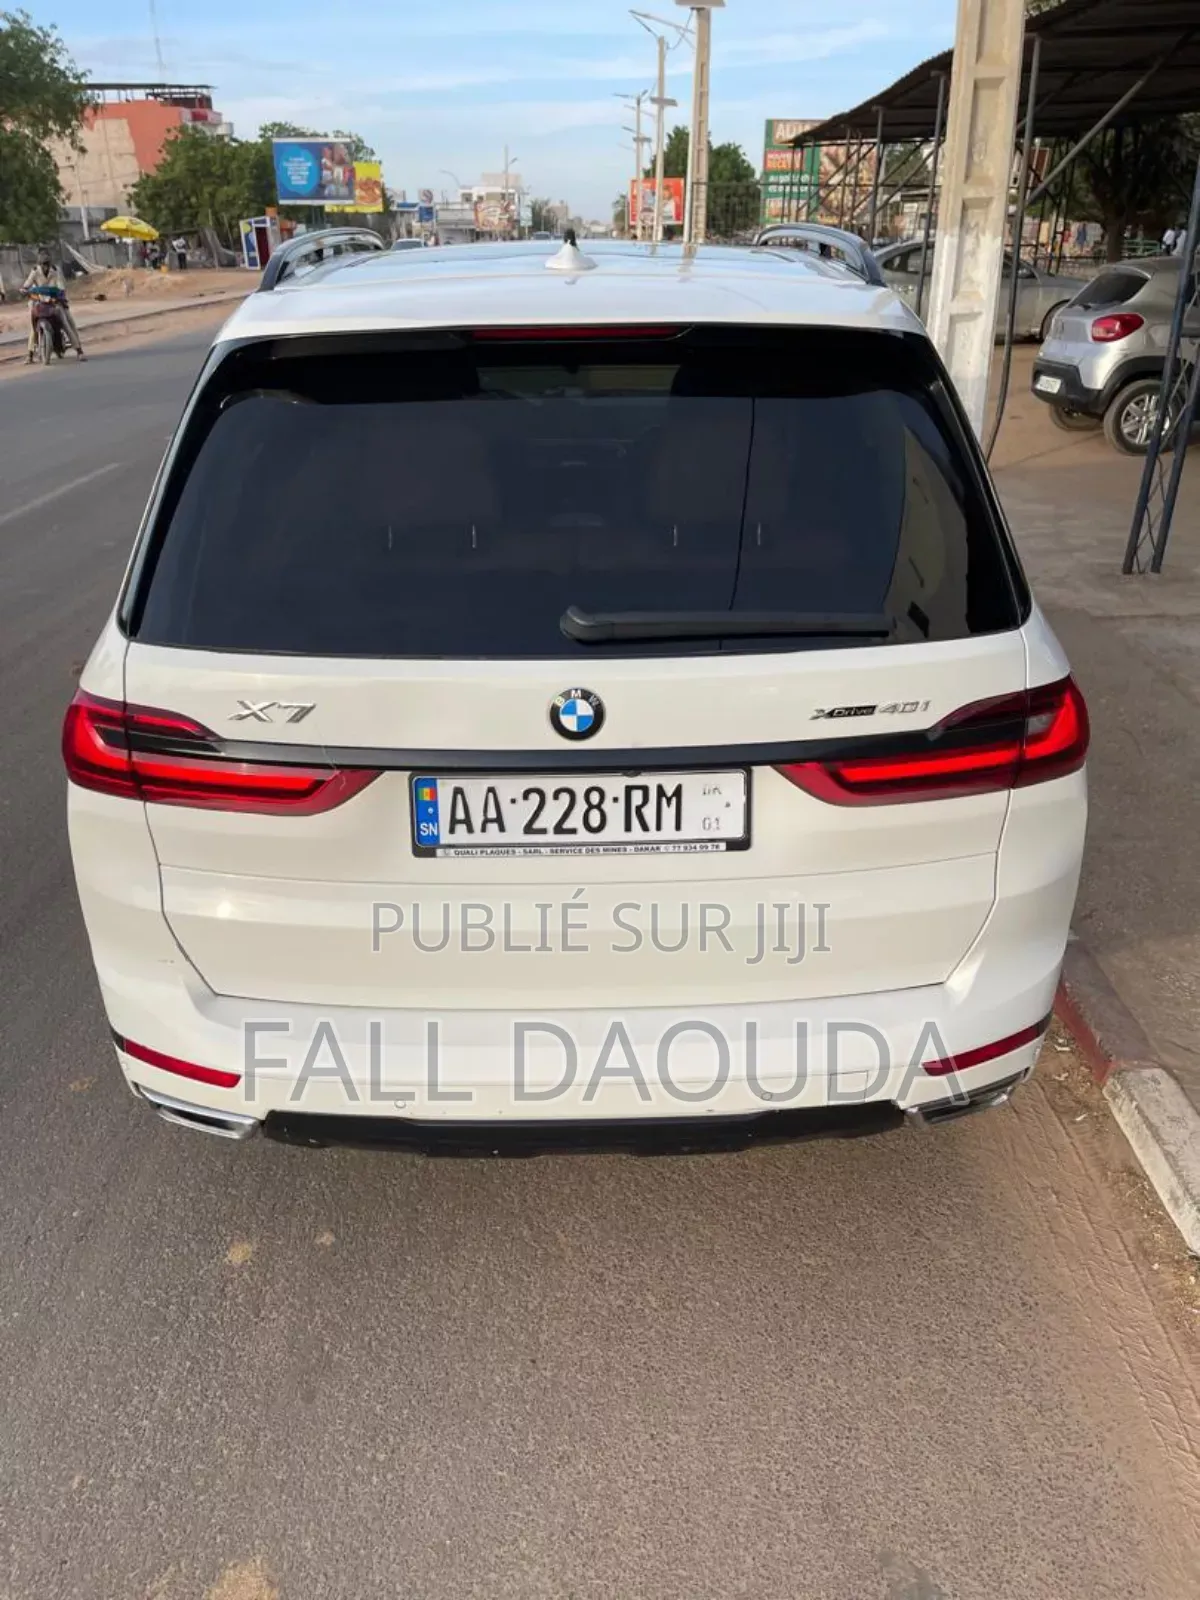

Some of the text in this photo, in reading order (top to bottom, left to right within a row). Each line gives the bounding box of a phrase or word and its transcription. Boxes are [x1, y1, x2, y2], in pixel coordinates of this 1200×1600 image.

[555, 689, 601, 706] BMW
[228, 701, 316, 723] X7
[420, 822, 438, 836] SN
[549, 847, 582, 855] SERVICE
[633, 844, 661, 852] DAKAR
